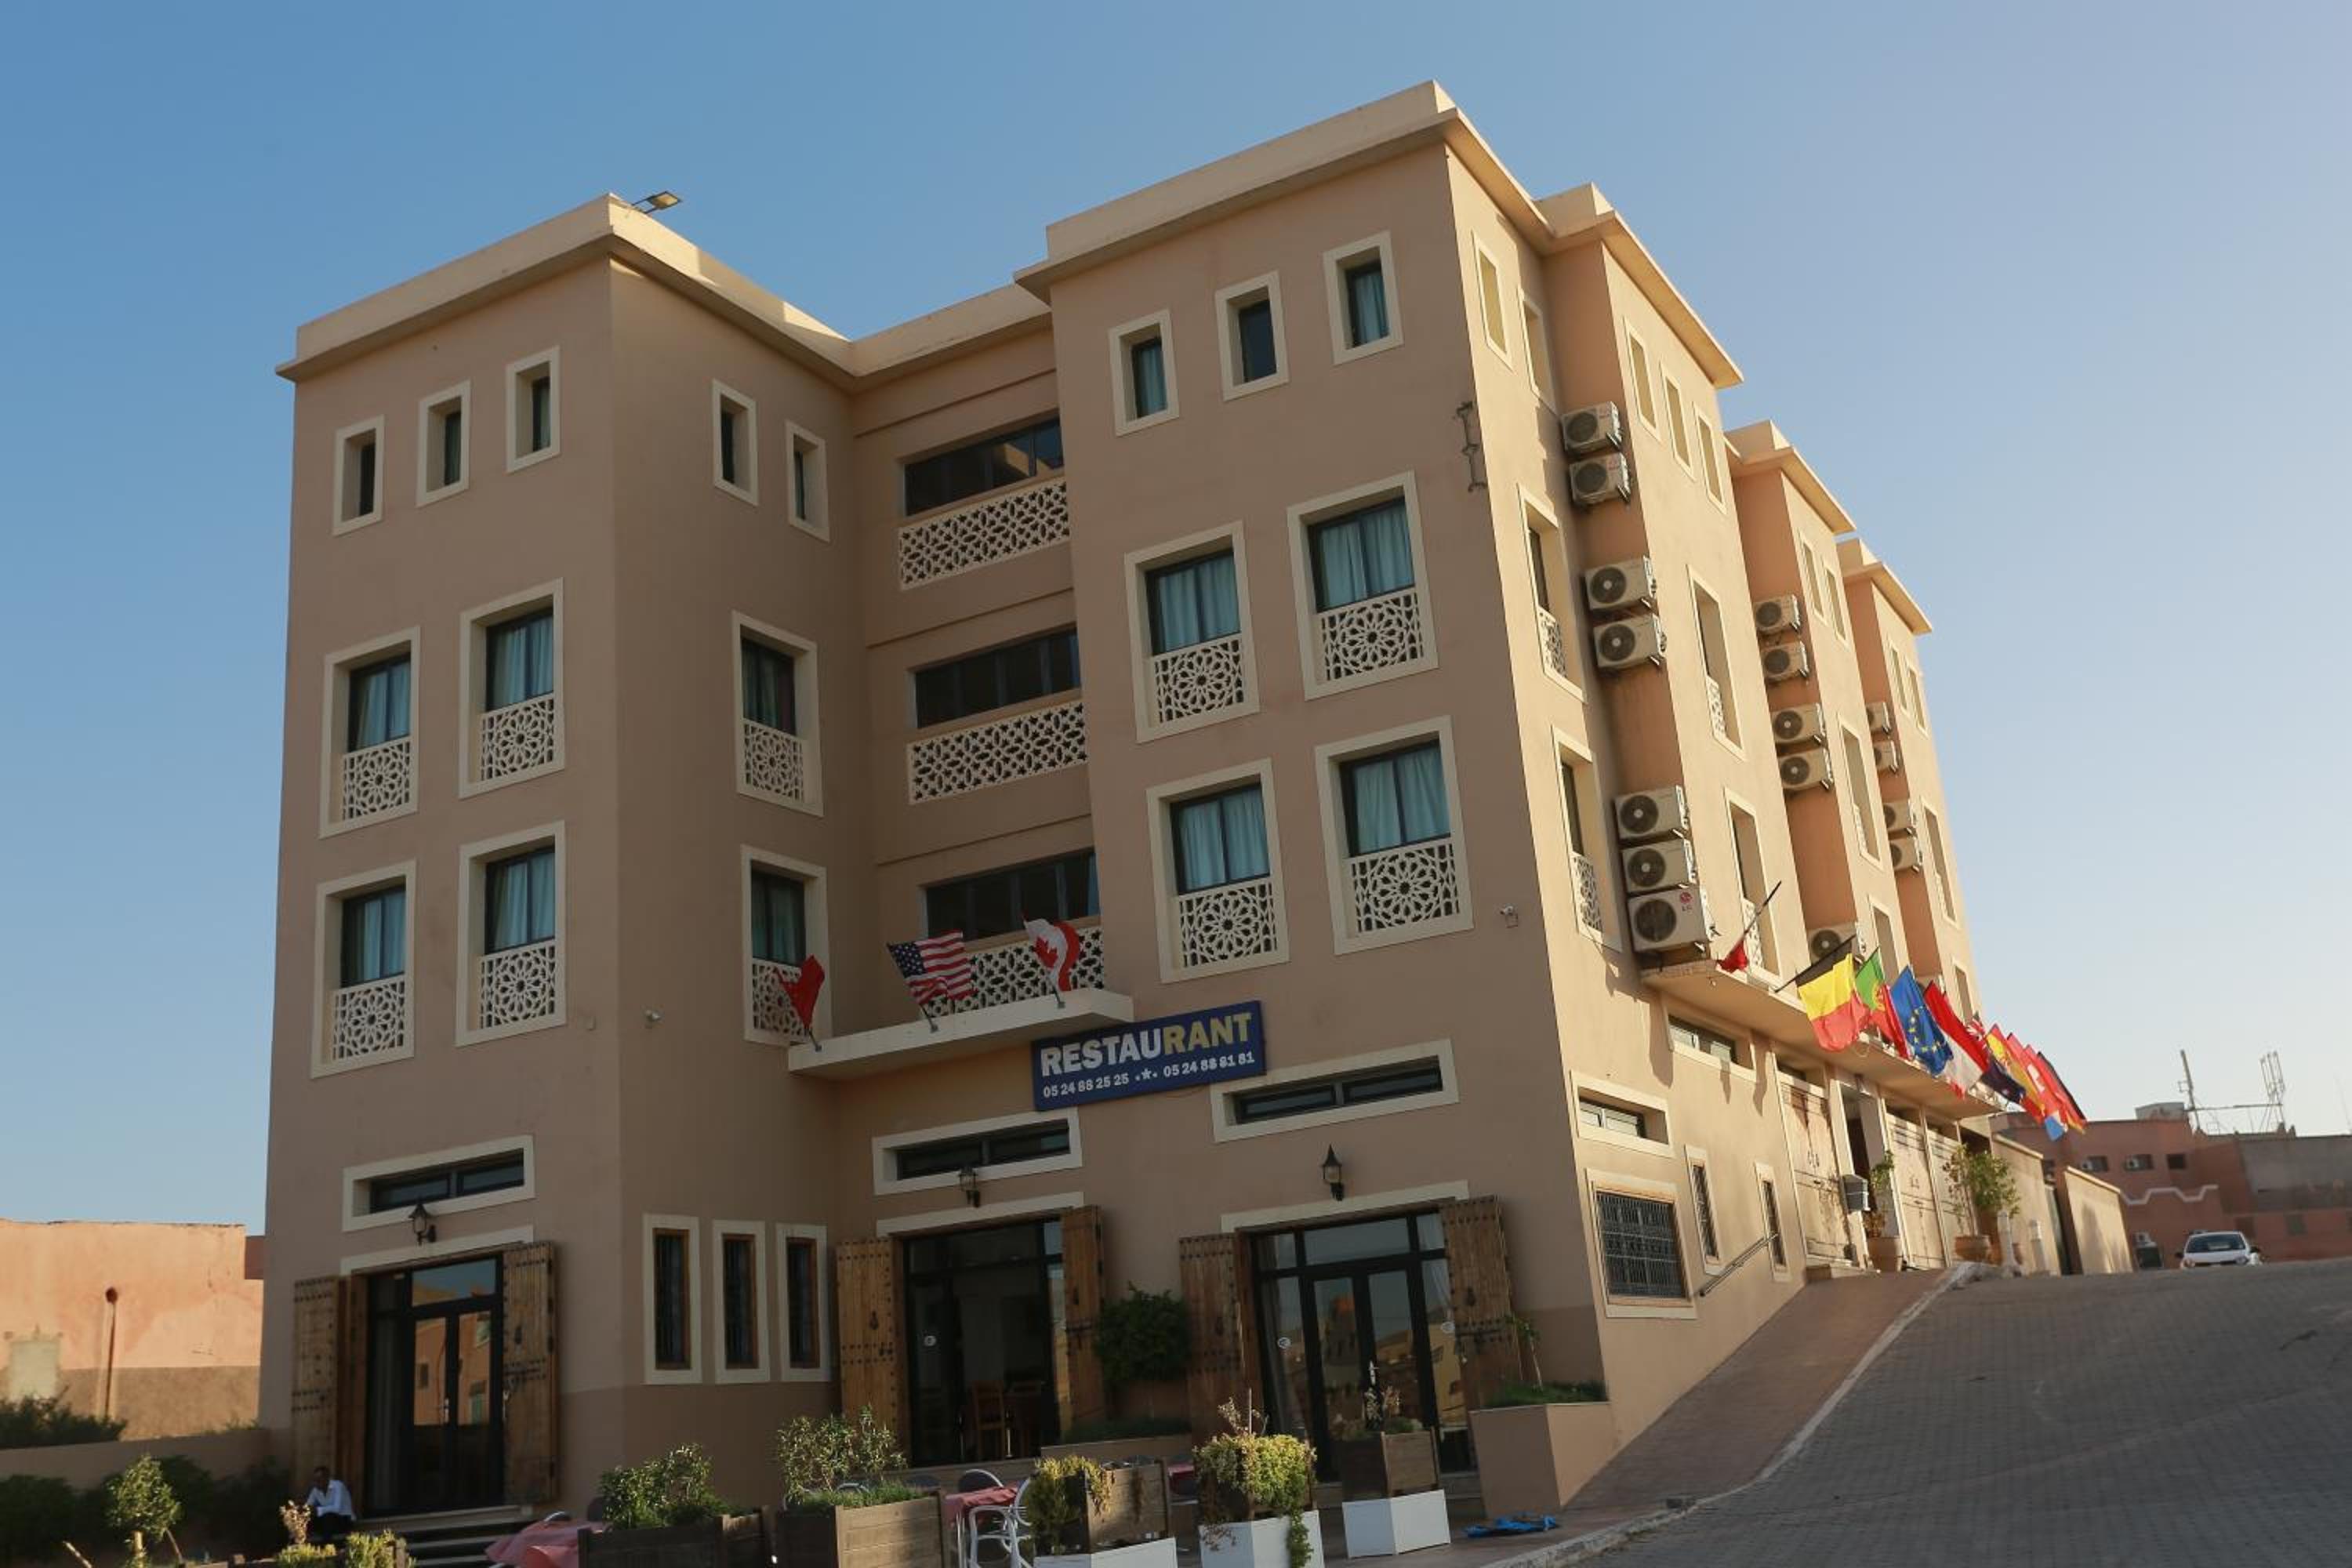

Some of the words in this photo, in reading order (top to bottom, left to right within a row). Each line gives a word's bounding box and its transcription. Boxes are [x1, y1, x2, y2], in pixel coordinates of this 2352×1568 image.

[1040, 1013, 1252, 1077] RESTAURANT
[1044, 1084, 1058, 1098] 05
[1061, 1081, 1076, 1095] 24
[1078, 1079, 1094, 1092] 88
[1096, 1076, 1111, 1089] 25
[1113, 1072, 1129, 1086] 25
[1163, 1064, 1180, 1077] 05
[1181, 1061, 1198, 1075] 24
